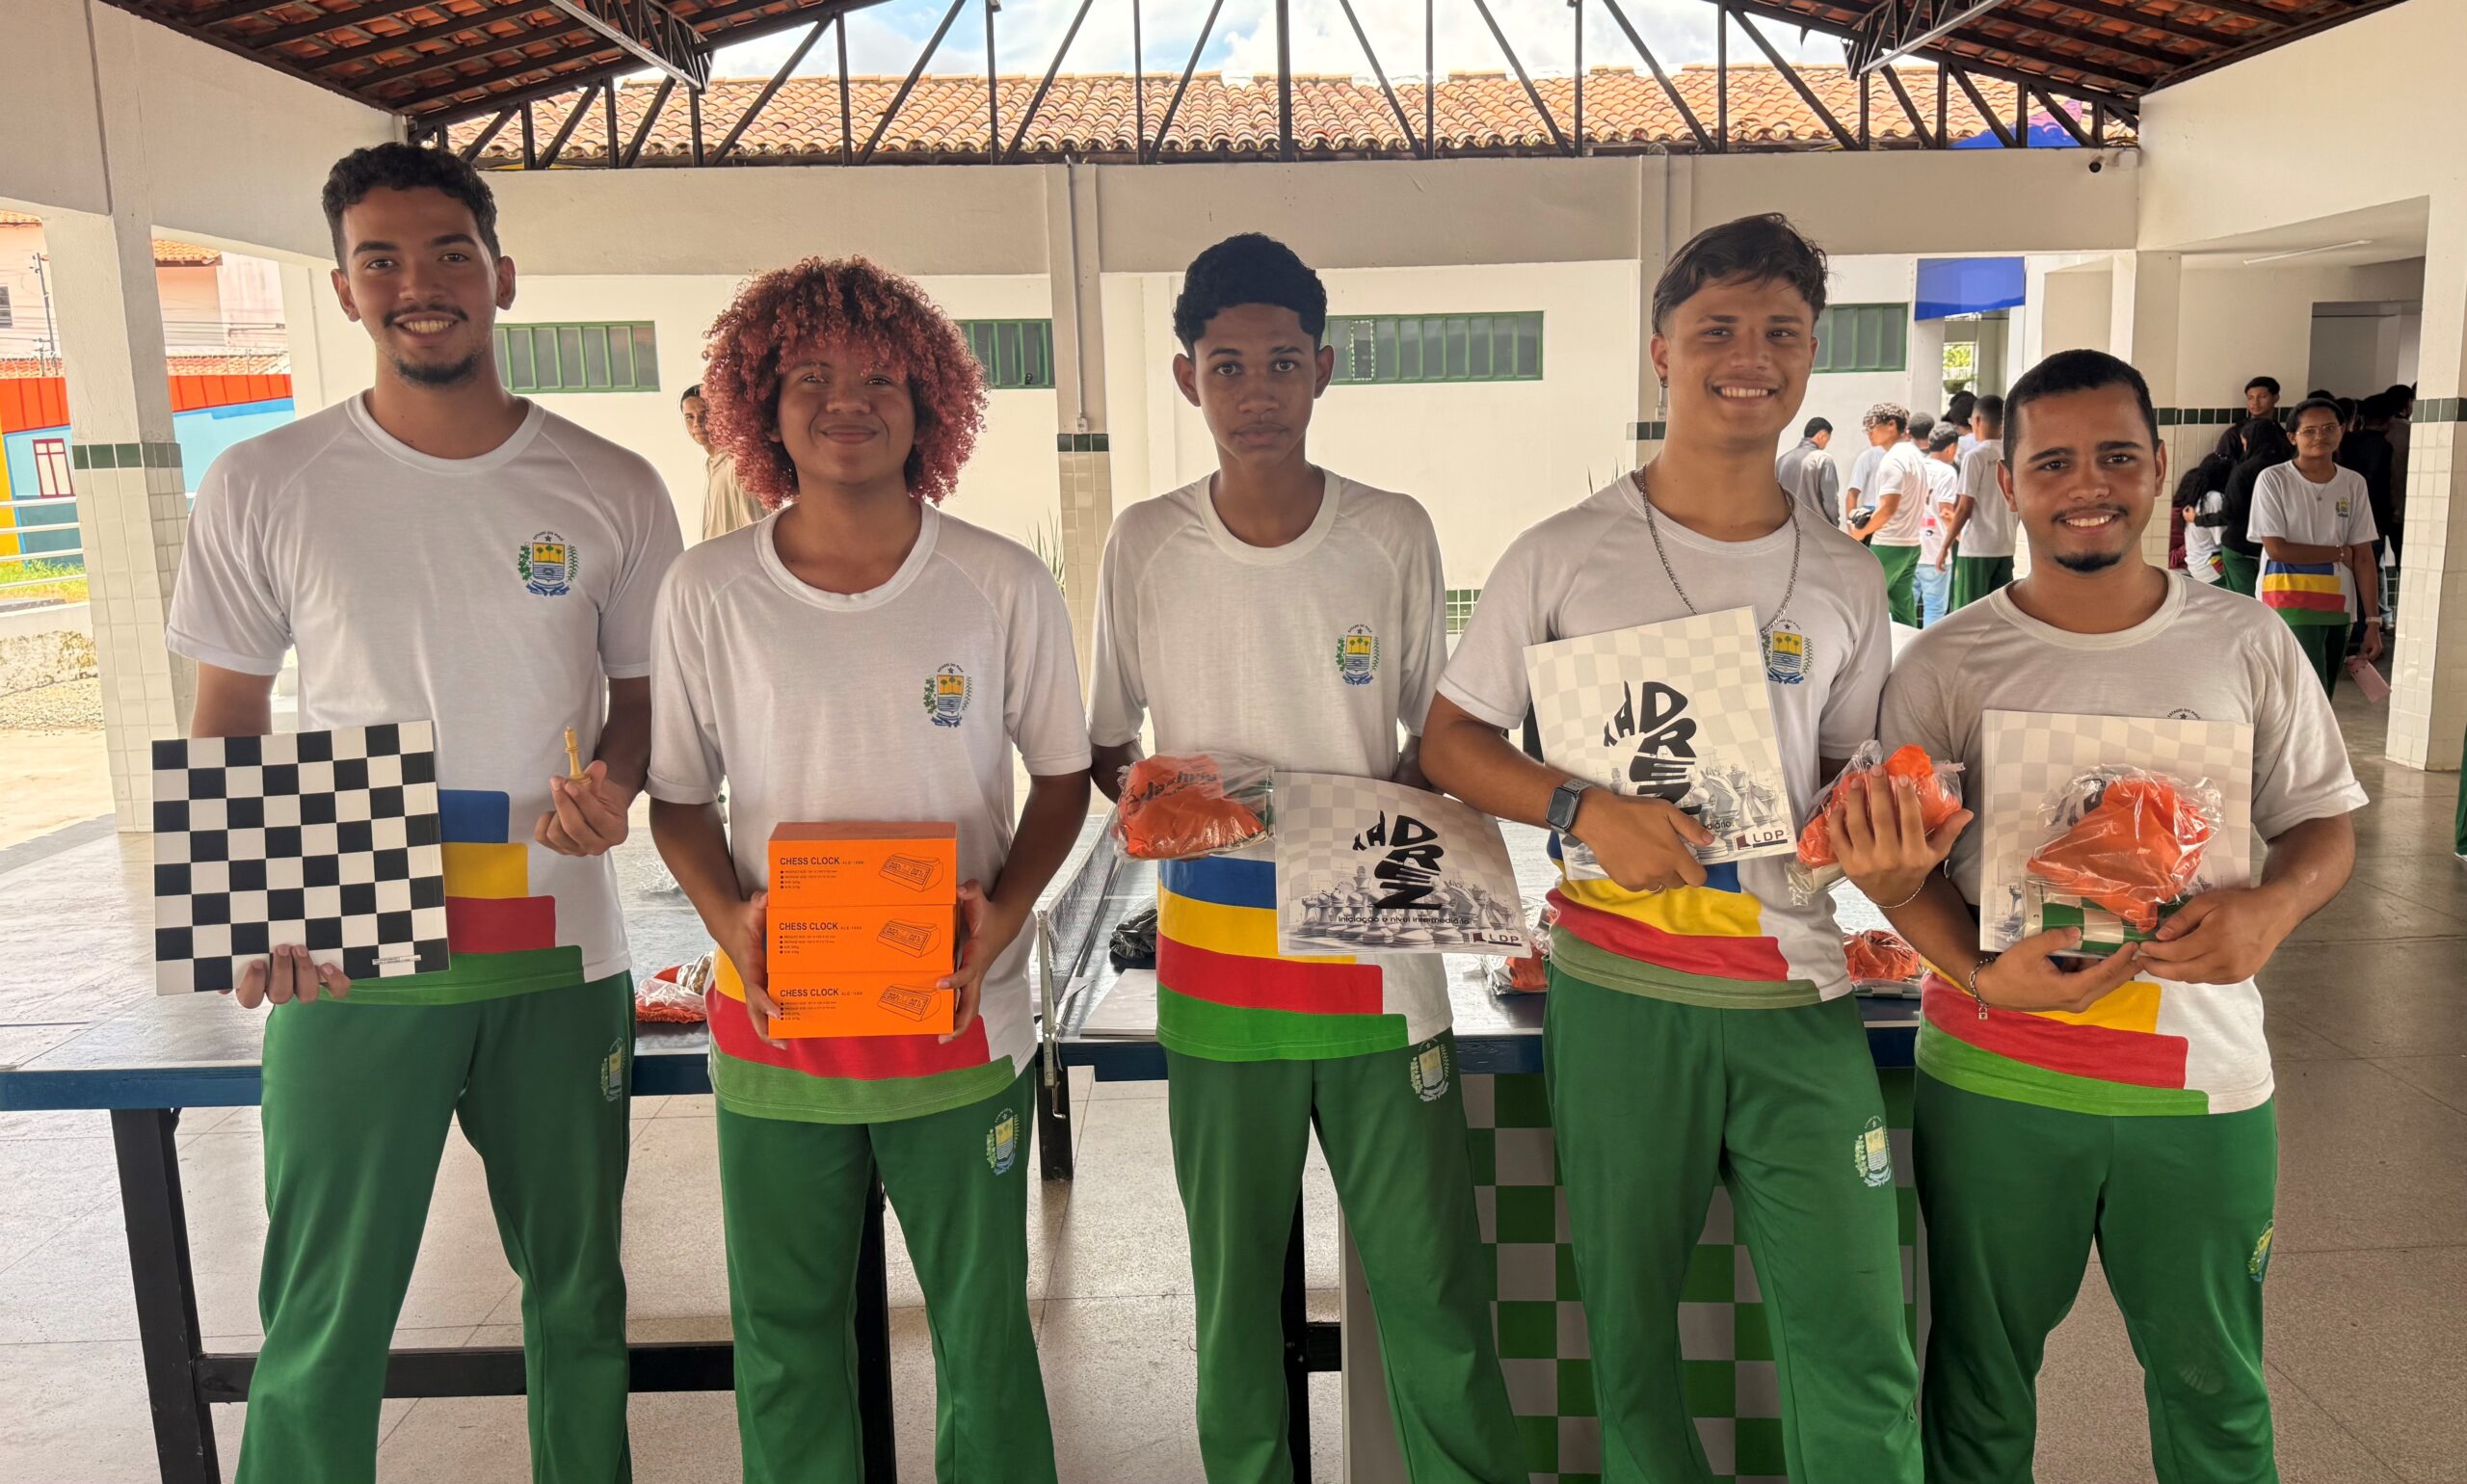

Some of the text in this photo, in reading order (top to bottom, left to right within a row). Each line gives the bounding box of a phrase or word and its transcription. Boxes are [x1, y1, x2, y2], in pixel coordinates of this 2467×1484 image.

[1752, 830, 1785, 843] LDP
[780, 857, 809, 865] CHESS
[810, 857, 840, 865] CLOCK
[779, 922, 808, 931] CHESS
[809, 922, 838, 931] CLOCK
[1489, 934, 1520, 942] LDP
[780, 989, 809, 997] CHESS
[809, 988, 839, 996] CLOCK
